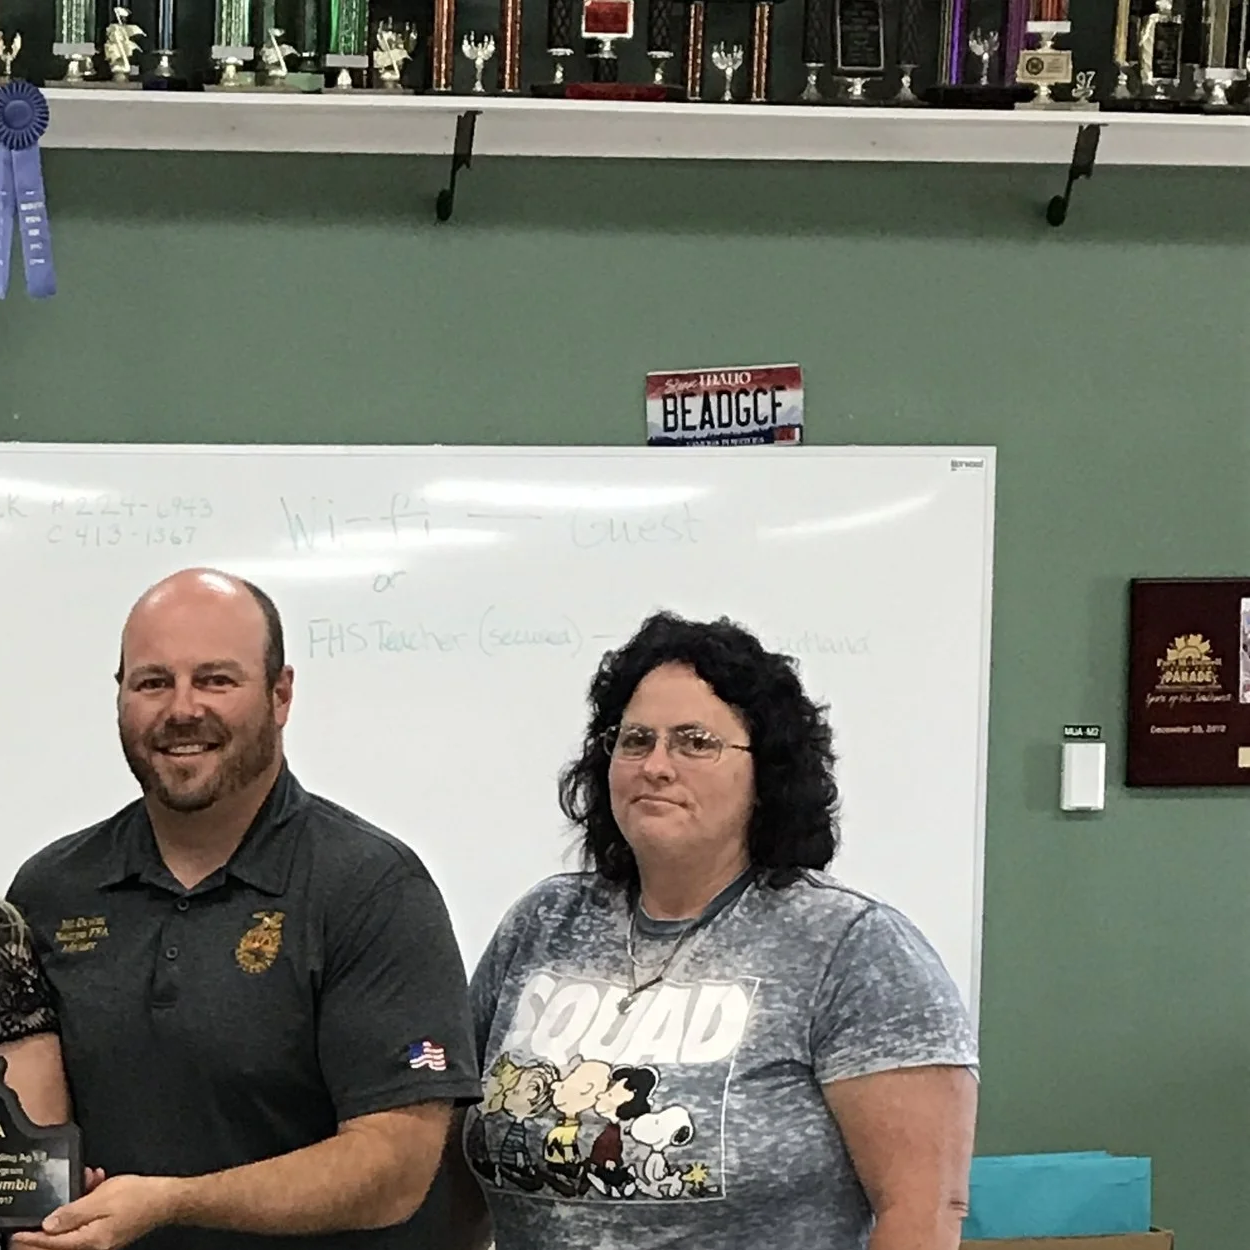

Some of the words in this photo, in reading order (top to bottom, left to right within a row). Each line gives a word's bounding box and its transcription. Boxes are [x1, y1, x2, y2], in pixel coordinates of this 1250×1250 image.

[1076, 71, 1096, 89] 97
[699, 372, 752, 386] IDAHO
[662, 386, 787, 432] BEADGCF
[371, 569, 407, 593] or
[1165, 671, 1212, 683] PARADE
[500, 974, 749, 1066] SQUAD
